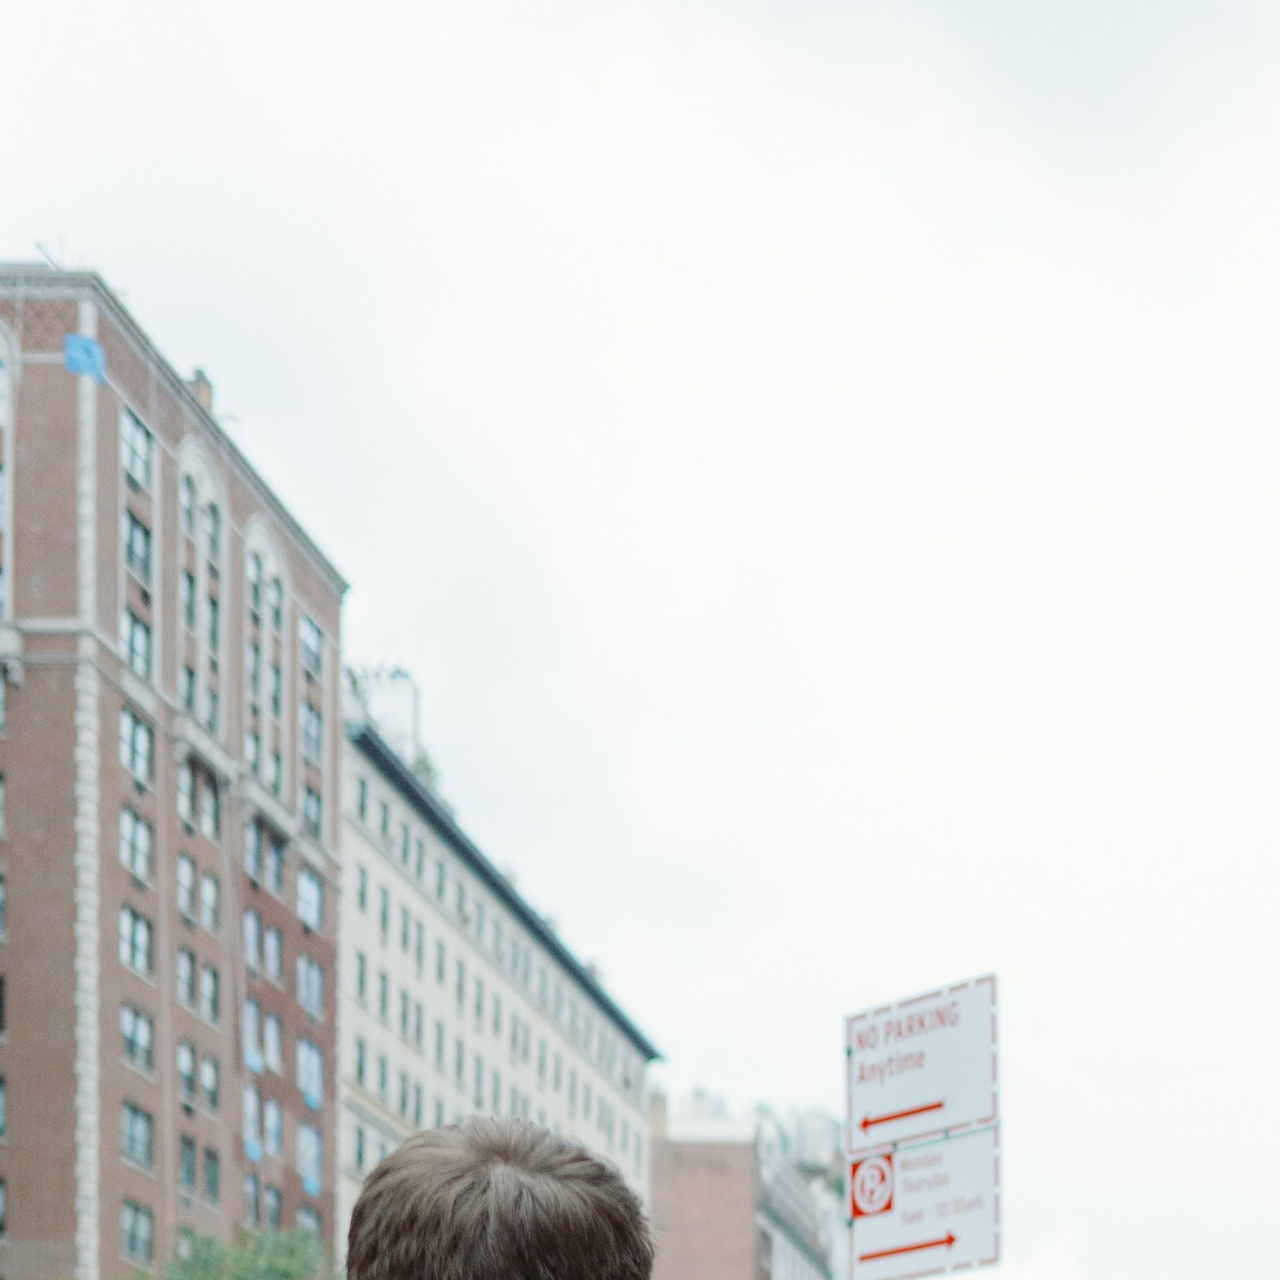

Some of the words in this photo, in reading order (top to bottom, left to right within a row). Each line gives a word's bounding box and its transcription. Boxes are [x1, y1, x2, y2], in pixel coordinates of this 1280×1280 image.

[856, 1025, 879, 1050] NO
[884, 1001, 960, 1045] PARKING
[858, 1050, 926, 1085] Anytime
